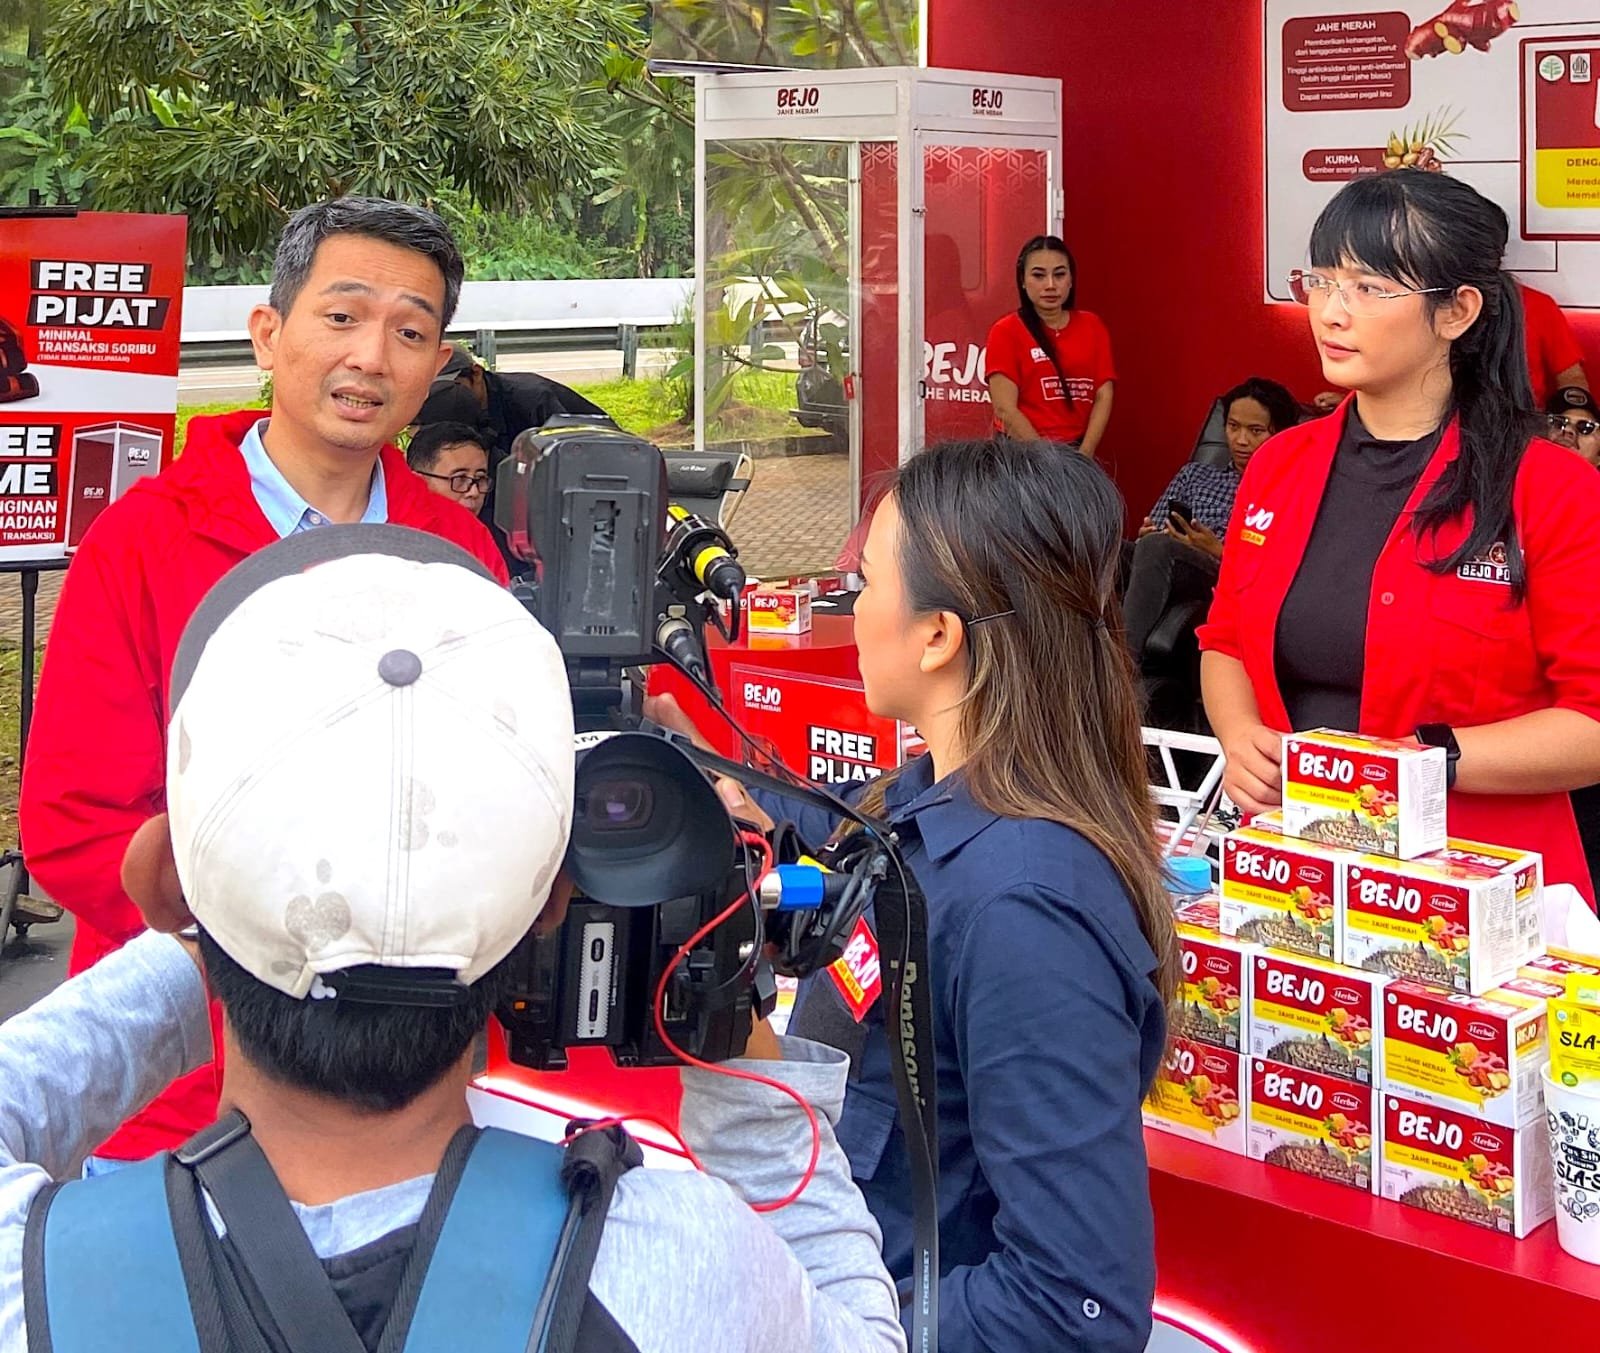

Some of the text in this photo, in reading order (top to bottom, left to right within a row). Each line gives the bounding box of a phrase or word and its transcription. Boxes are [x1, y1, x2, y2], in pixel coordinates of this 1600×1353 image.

[1314, 20, 1376, 33] JAHE MERAH
[777, 87, 820, 108] BEJO
[972, 88, 1003, 109] BEJO
[1325, 155, 1360, 165] KURMA
[1567, 158, 1600, 167] DENG
[38, 261, 145, 293] FREE
[36, 295, 157, 327] PIJAT
[38, 329, 94, 342] MINIMAL
[38, 341, 157, 355] TRANSAKSI 50RIBU
[925, 388, 992, 404] HE MERA
[1462, 564, 1511, 581] BEJO PO
[754, 598, 779, 608] BEJO
[743, 682, 782, 706] BEJO
[810, 725, 873, 762] FREE
[1298, 752, 1354, 784] BEJO
[1362, 766, 1387, 779] Herbal
[1235, 850, 1291, 885] BEJO
[1299, 868, 1323, 881] Herbal
[1360, 879, 1422, 914] BEJO
[1431, 897, 1457, 910] Herbal
[843, 933, 881, 990] BEJO
[1206, 958, 1231, 972] Herbal
[1266, 969, 1326, 1005] BEJO
[1334, 990, 1360, 1003] Herbal
[1397, 1004, 1458, 1043] BEJO
[1469, 1024, 1496, 1038] Herbal
[1263, 1072, 1324, 1110] BEJO
[1333, 1095, 1359, 1108] Herbal
[1398, 1110, 1463, 1150] BEJO
[1473, 1135, 1500, 1149] Herbal
[922, 1247, 930, 1316] ETHERNET
